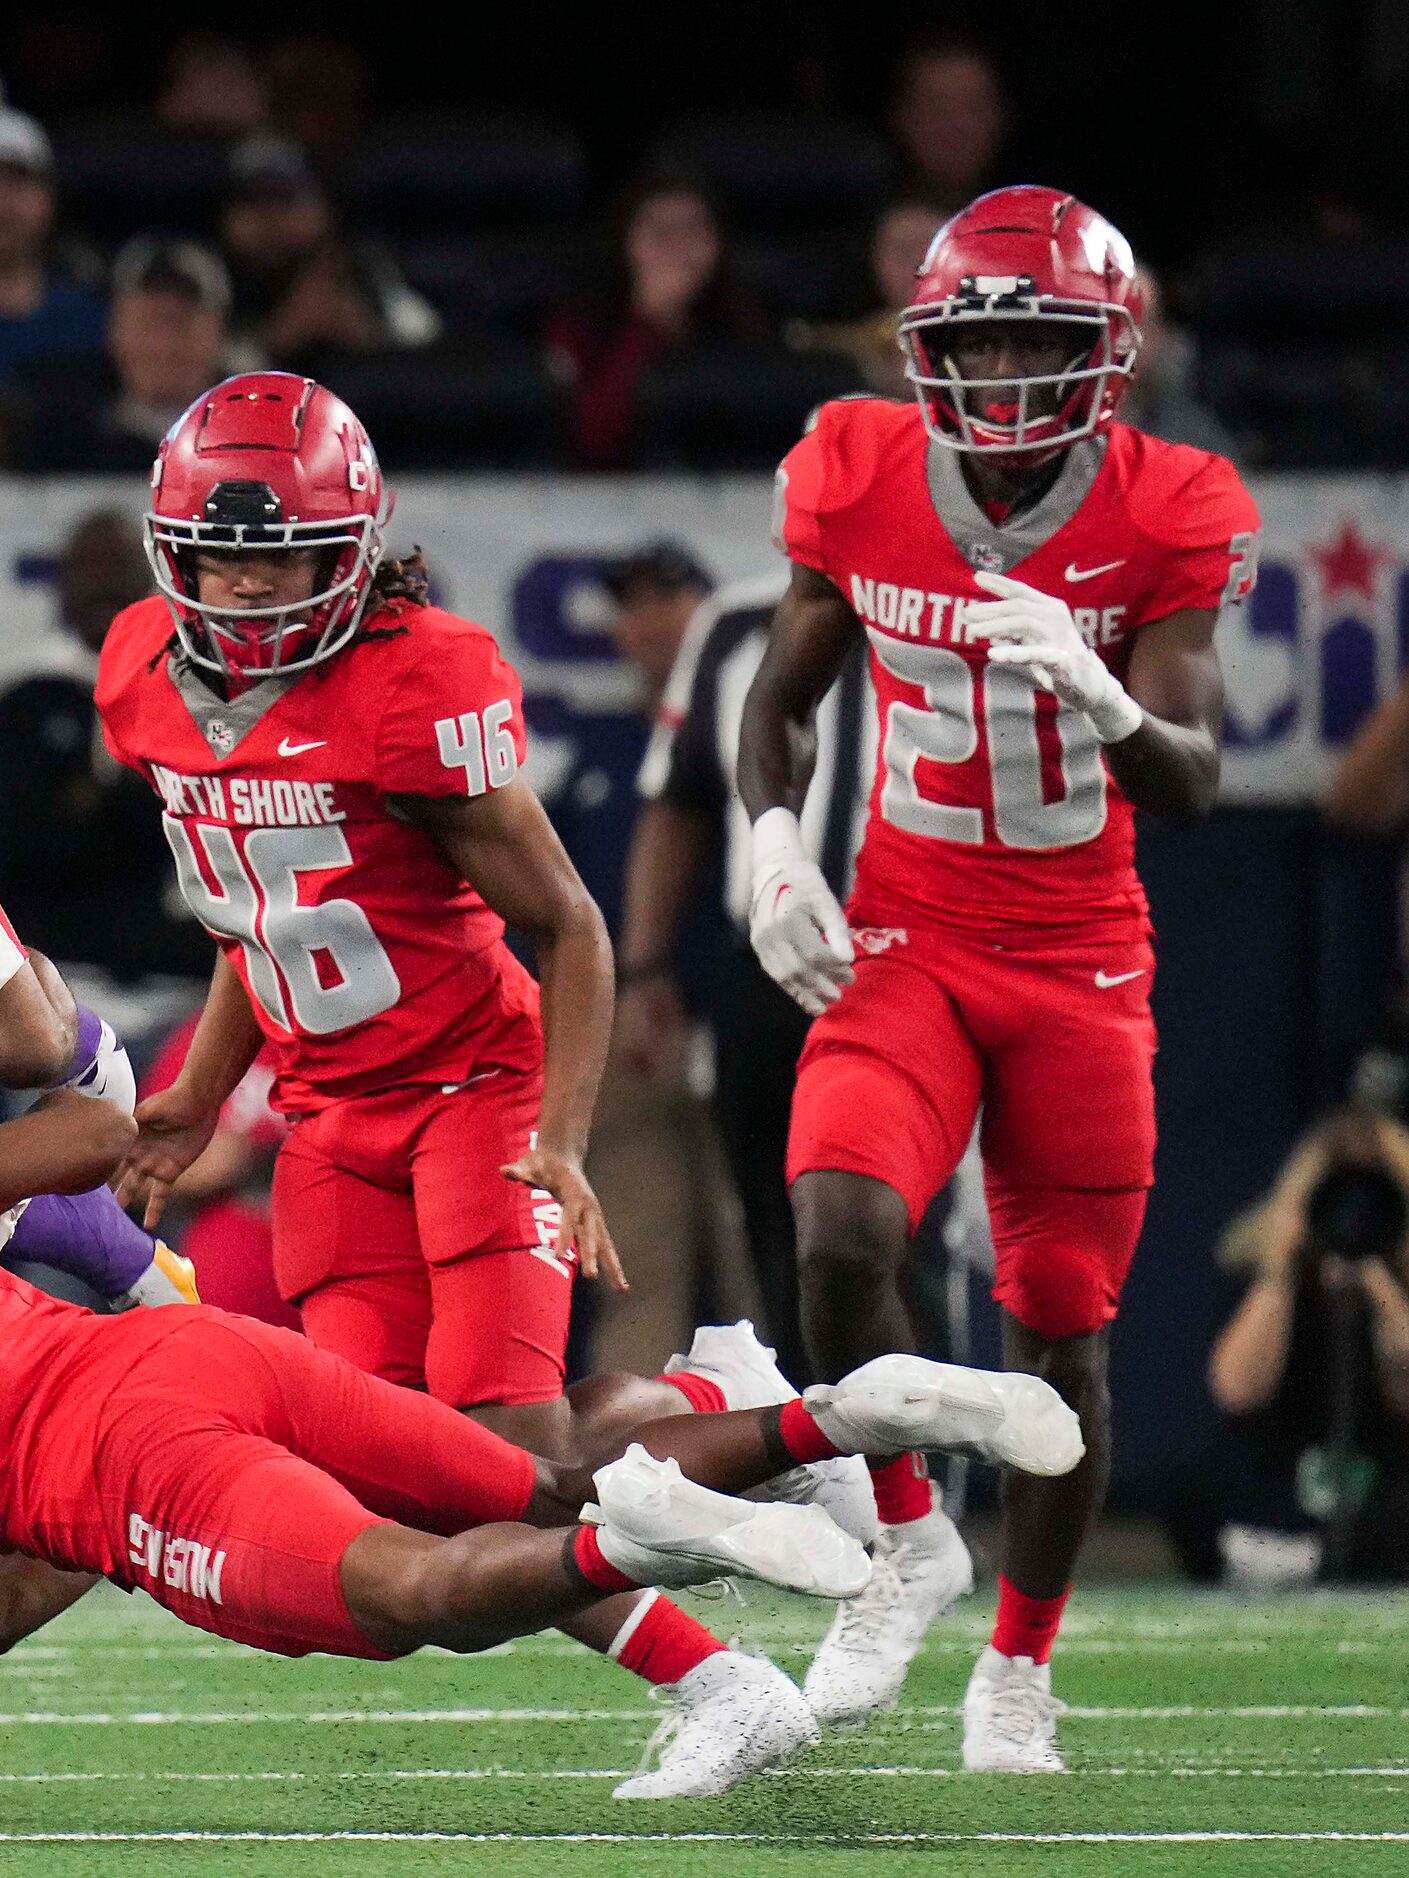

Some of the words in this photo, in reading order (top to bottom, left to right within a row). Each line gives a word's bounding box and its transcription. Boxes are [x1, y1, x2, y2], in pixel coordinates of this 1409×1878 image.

[229, 778, 347, 826] SHORE
[433, 698, 518, 798] 46
[866, 623, 1108, 853] 20
[162, 809, 402, 1035] 46
